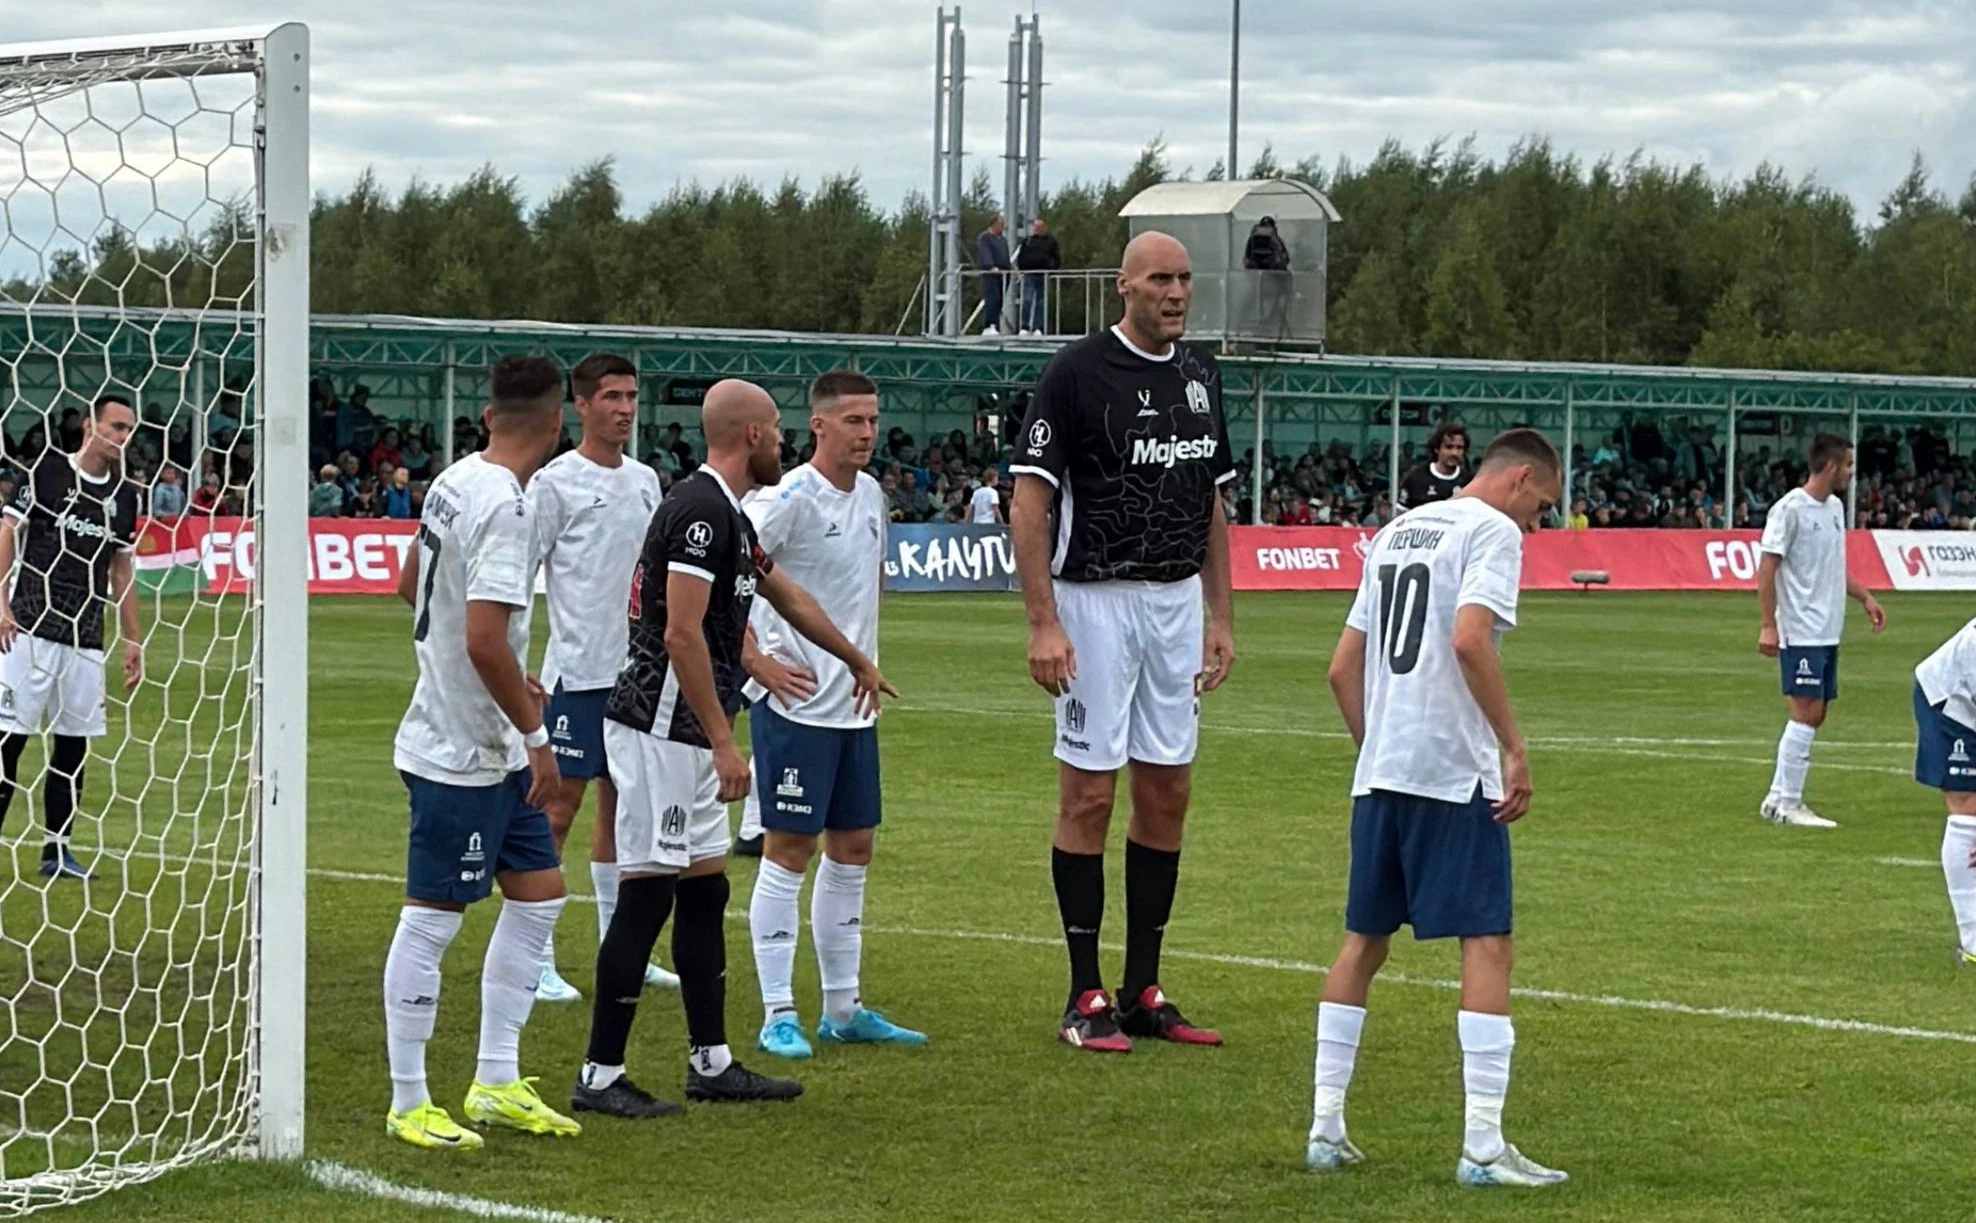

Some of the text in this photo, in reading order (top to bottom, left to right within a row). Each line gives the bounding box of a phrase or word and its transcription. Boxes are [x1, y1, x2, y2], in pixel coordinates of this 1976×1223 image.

[1131, 434, 1218, 469] Majest
[201, 532, 415, 580] FOBET
[1257, 547, 1340, 570] FONBET
[1378, 562, 1430, 675] 10
